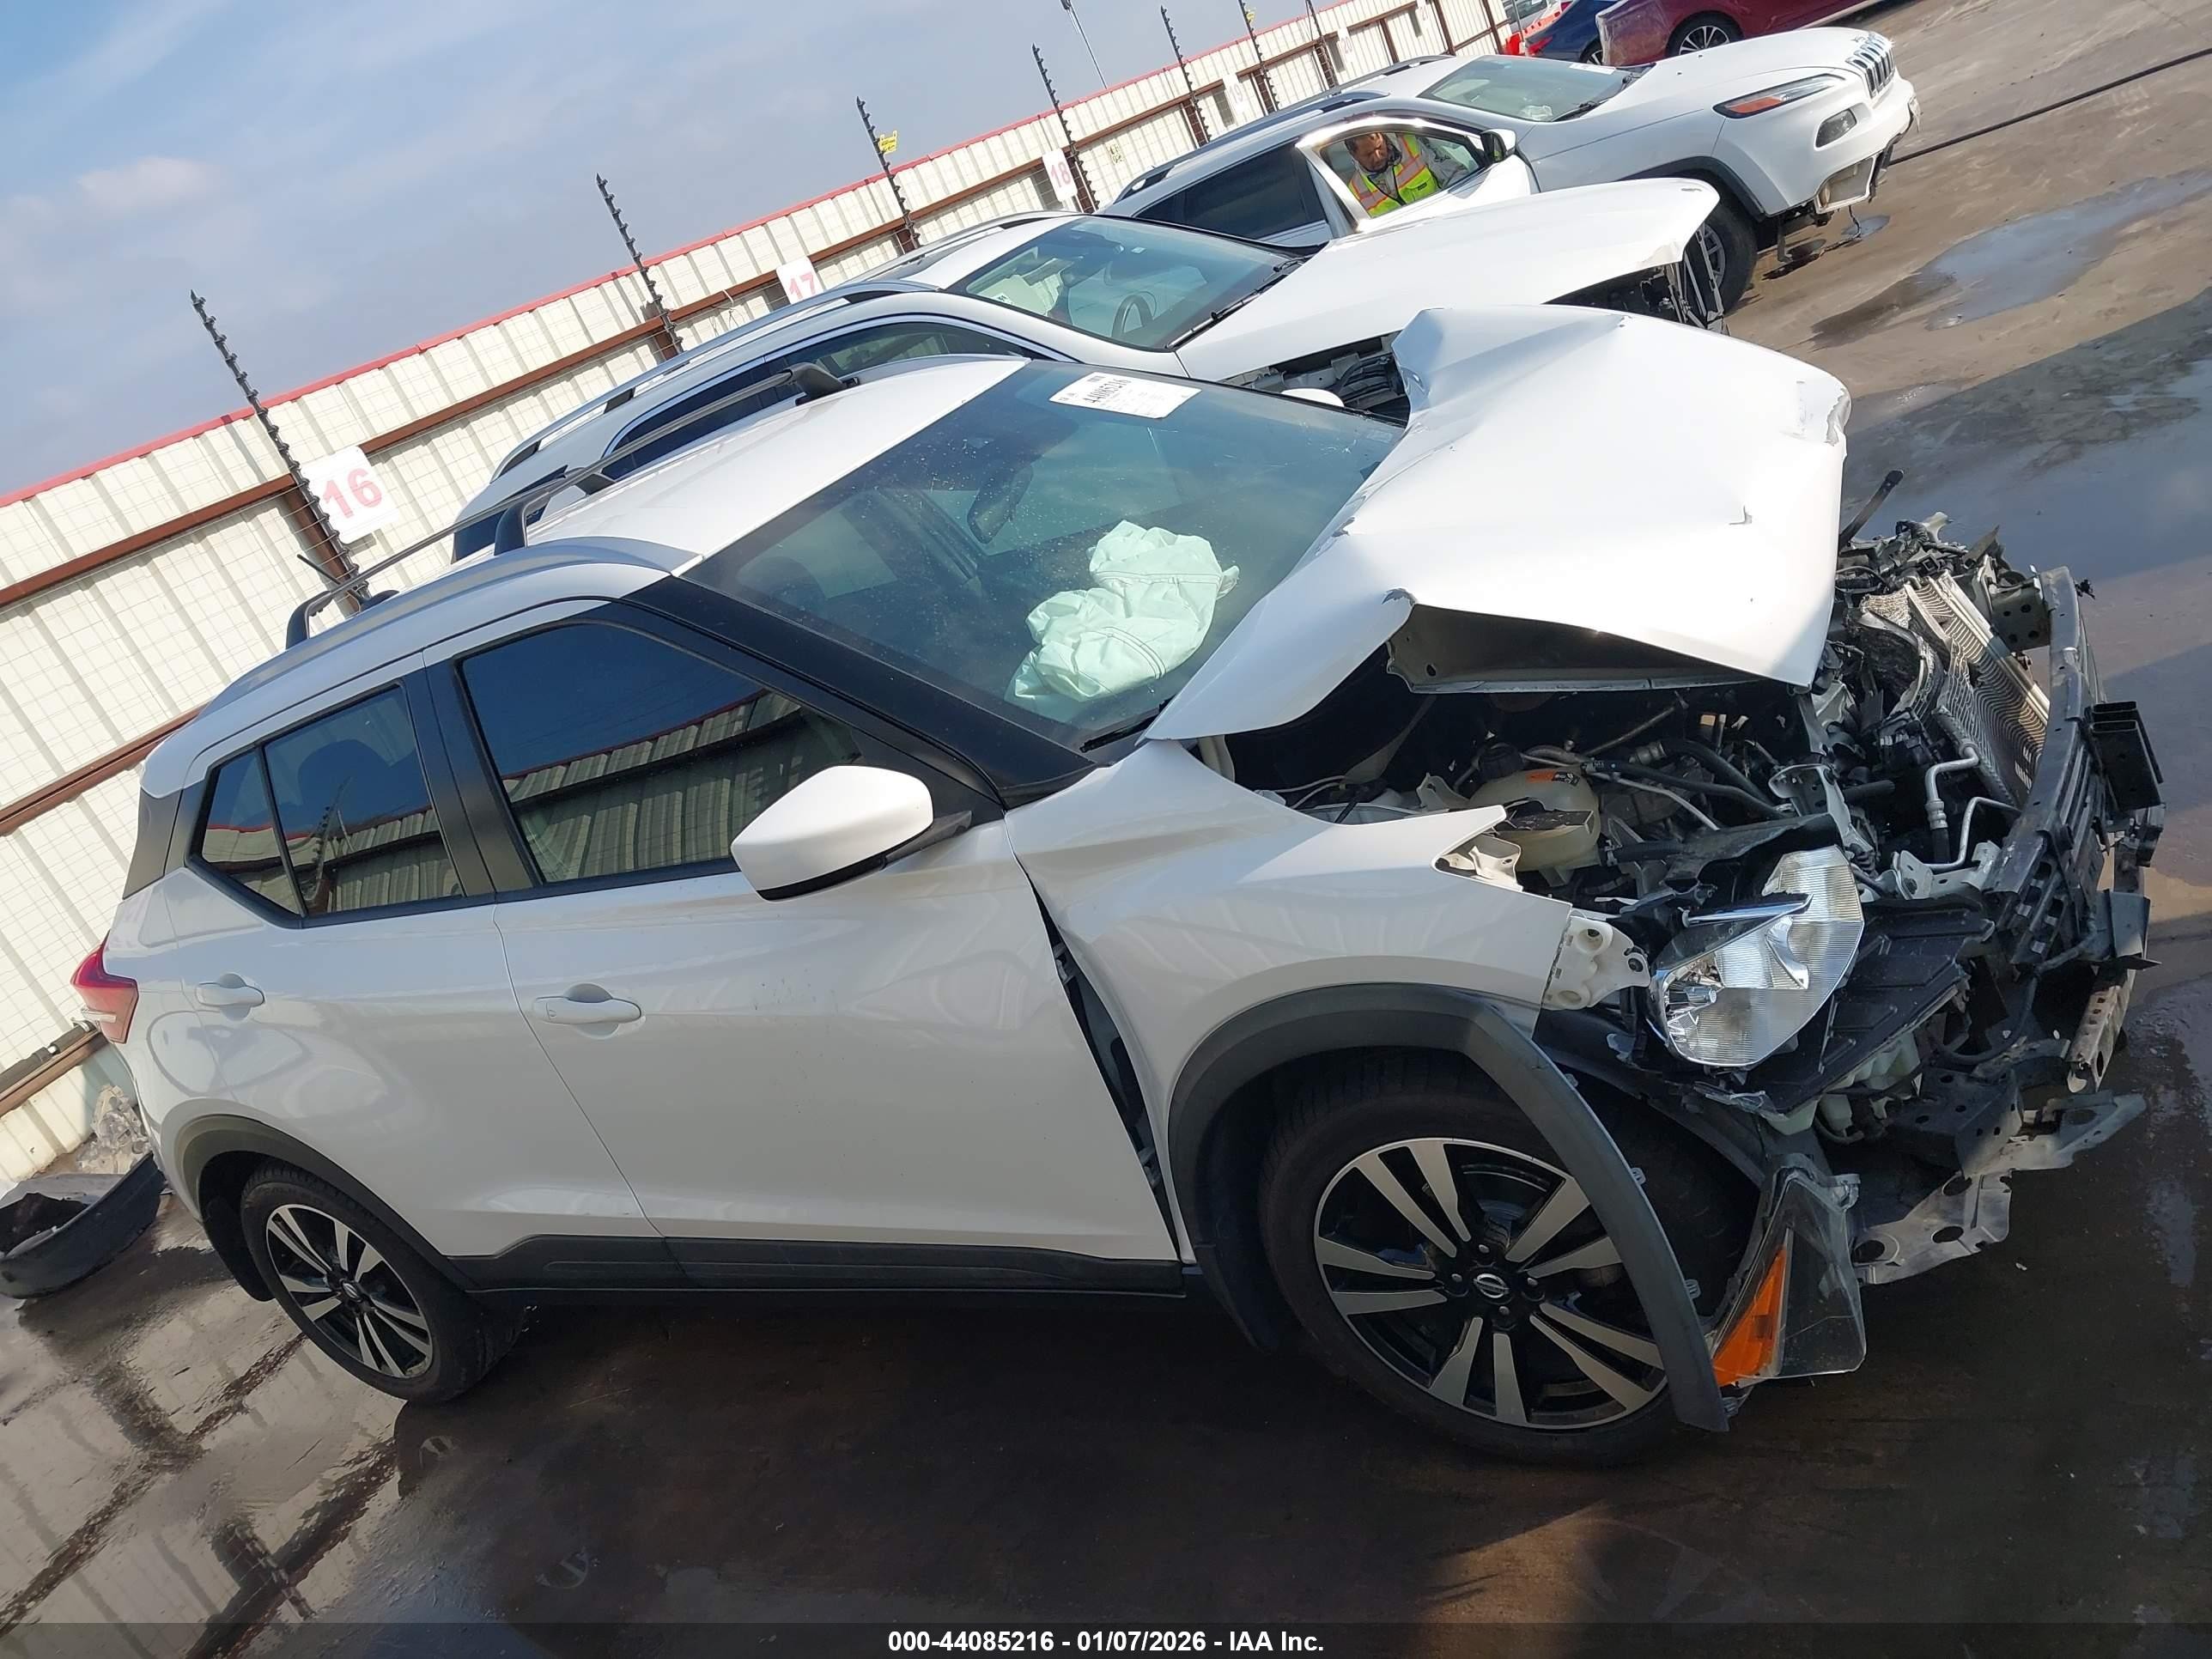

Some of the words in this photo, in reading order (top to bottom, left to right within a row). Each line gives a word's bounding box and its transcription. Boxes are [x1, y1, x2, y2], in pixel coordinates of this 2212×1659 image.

[1340, 36, 1353, 54] 20
[1229, 83, 1243, 104] 19
[1050, 161, 1072, 188] 18
[788, 271, 817, 301] 17
[322, 467, 383, 519] 16
